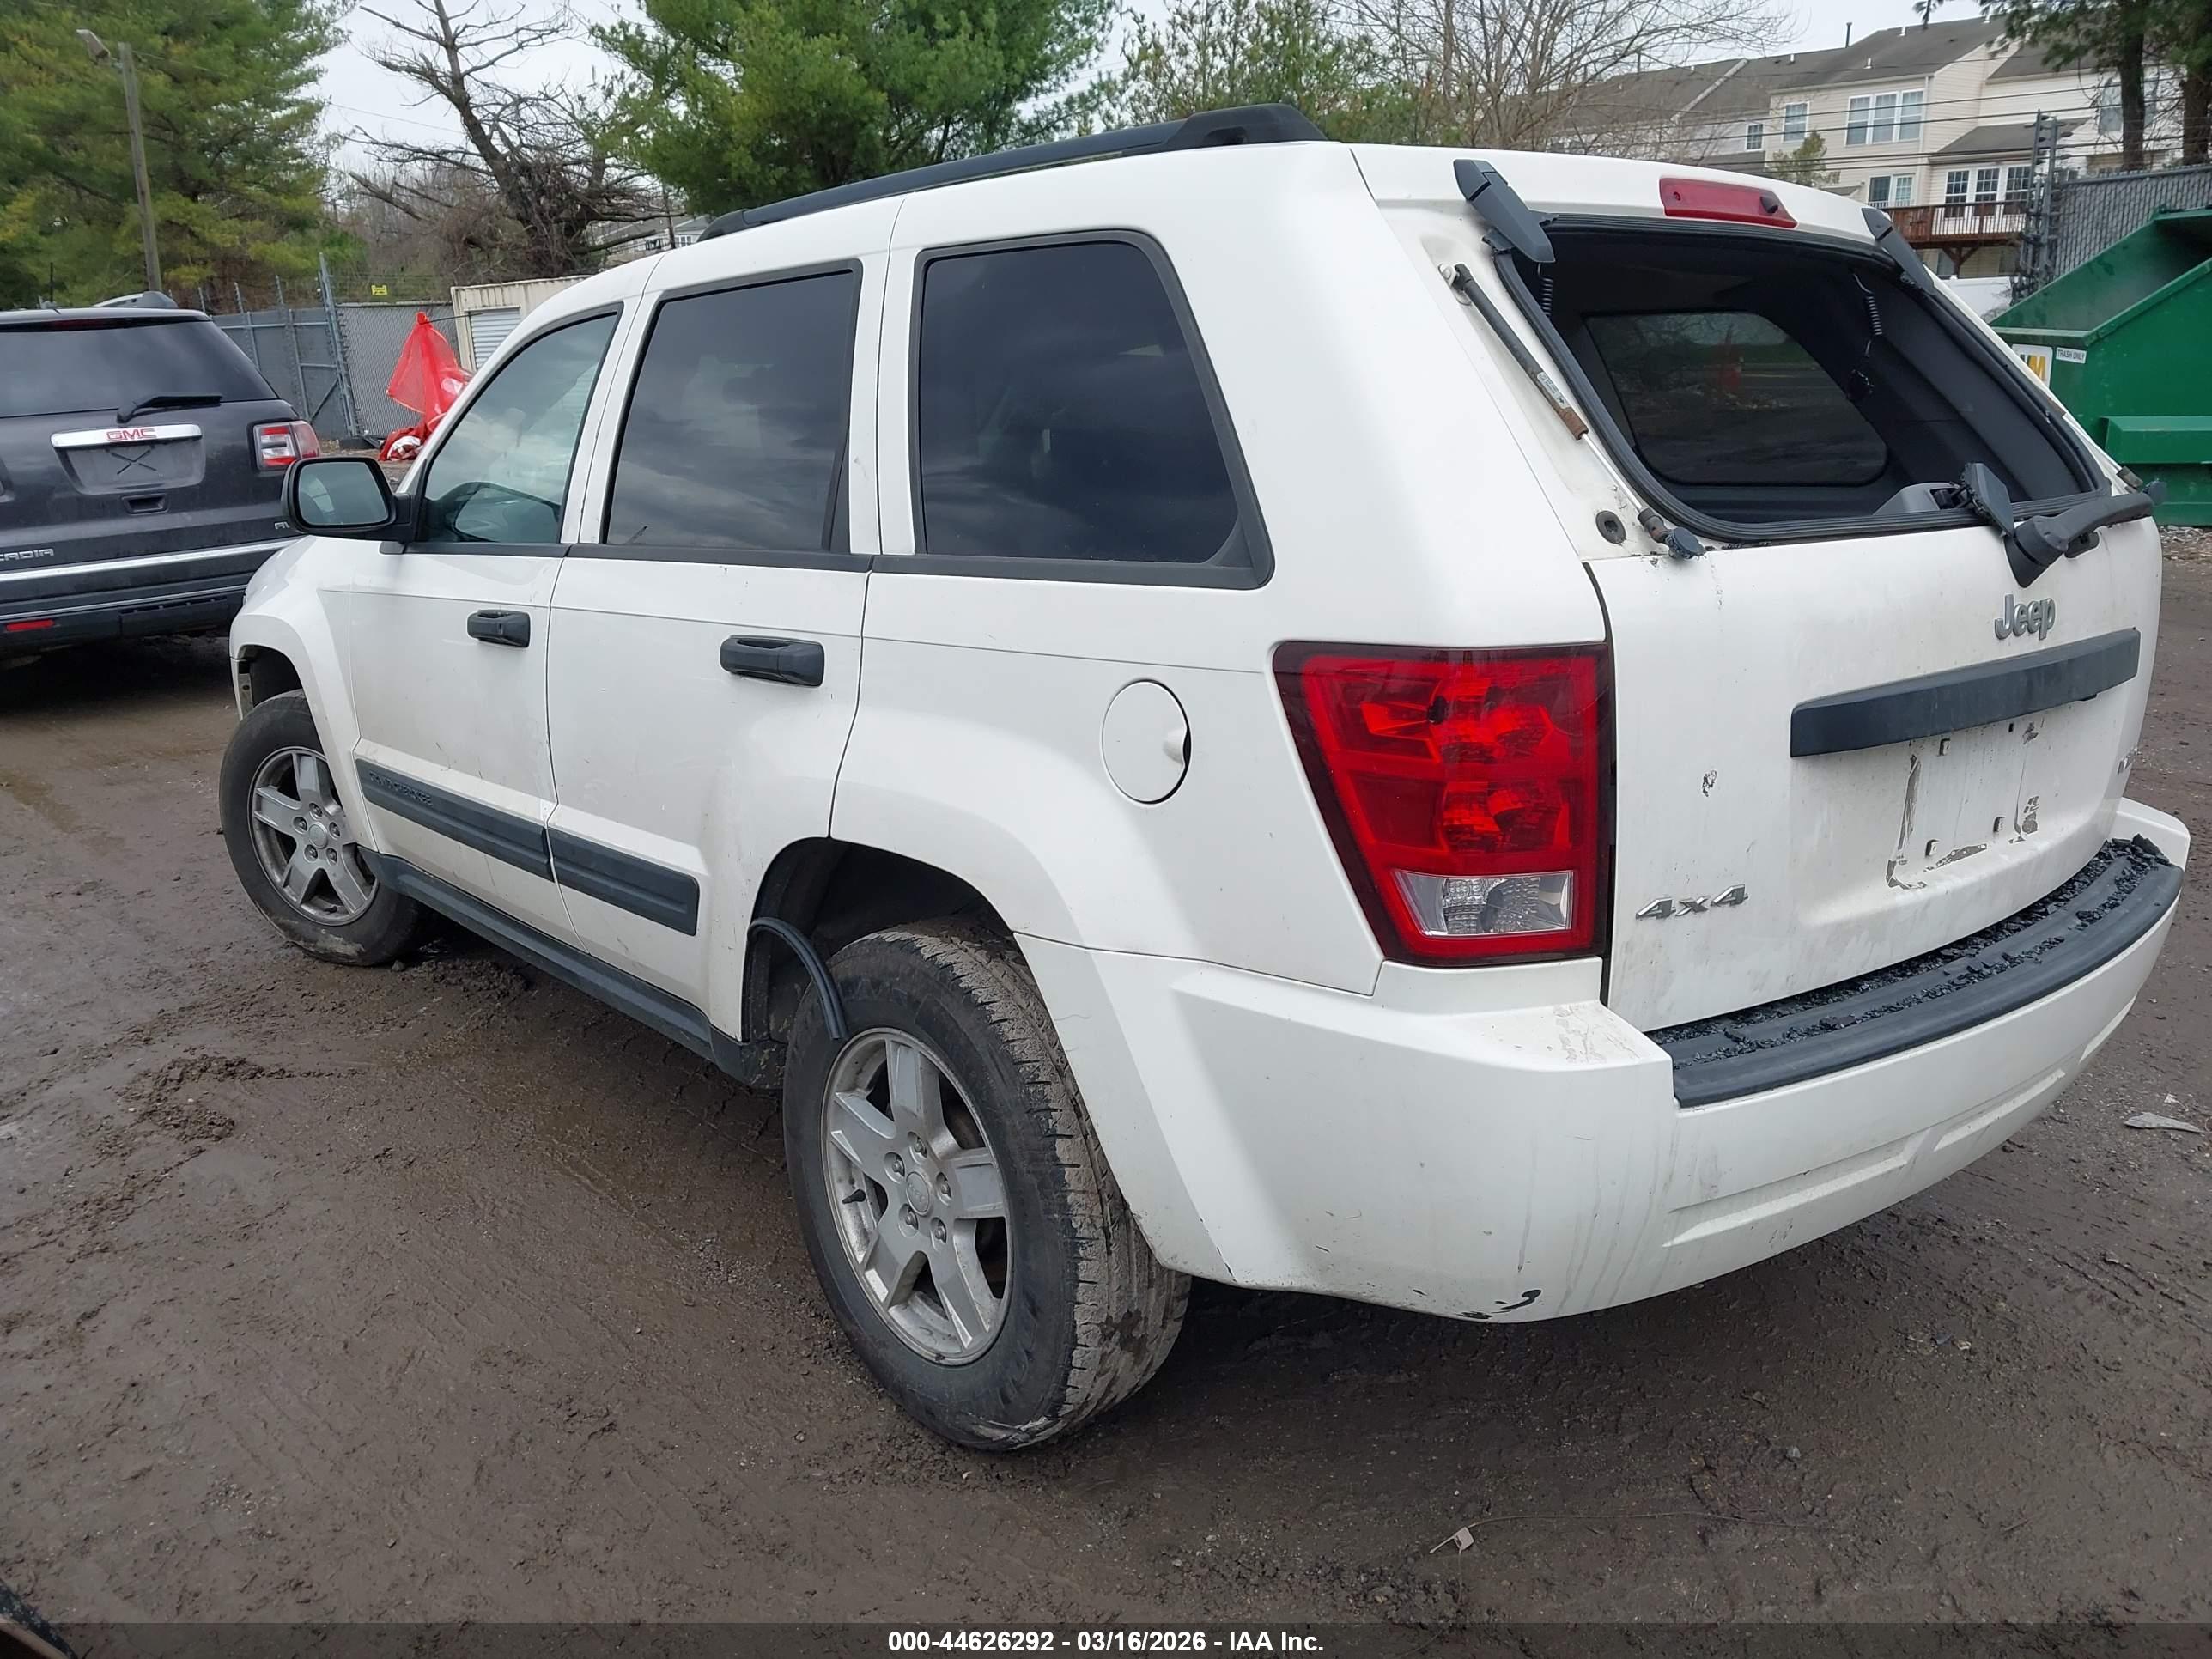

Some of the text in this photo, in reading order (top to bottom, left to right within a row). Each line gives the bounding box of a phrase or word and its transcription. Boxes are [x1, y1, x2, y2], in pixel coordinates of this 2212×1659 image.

[2057, 349, 2073, 358] TRASH
[106, 428, 156, 441] GMC
[1994, 593, 2056, 641] Jeep
